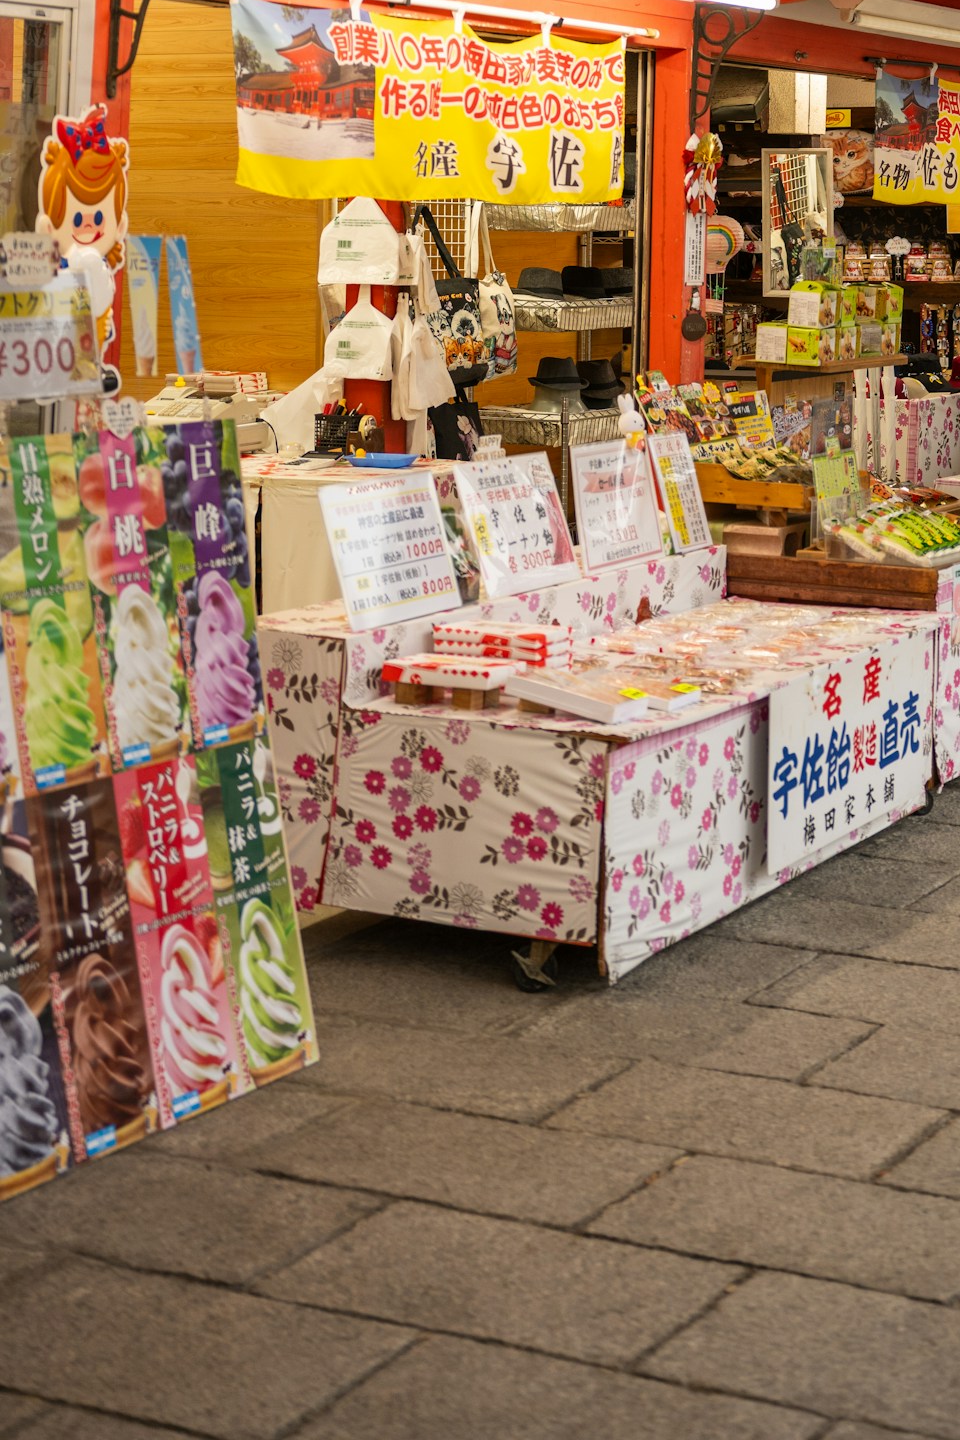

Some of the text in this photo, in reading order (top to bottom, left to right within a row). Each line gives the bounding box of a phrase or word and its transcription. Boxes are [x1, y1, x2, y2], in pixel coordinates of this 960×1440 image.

[414, 141, 459, 178] 名産
[879, 159, 911, 191] 名物
[18, 443, 53, 582] 甘熟メロン
[107, 448, 144, 558] 白桃
[189, 441, 222, 543] 巨峰
[406, 539, 444, 559] 1000円
[421, 575, 454, 595] 800円
[521, 549, 555, 571] 300円
[821, 656, 882, 721] 名産
[233, 746, 258, 842] バニラ&
[772, 690, 921, 821] 宇佐飴製造直売
[141, 781, 170, 915] ストロベリー
[156, 766, 181, 865] バニラ&
[802, 772, 896, 848] 梅田家本舗
[60, 794, 99, 939] チョコレート
[228, 825, 251, 884] 抹茶
